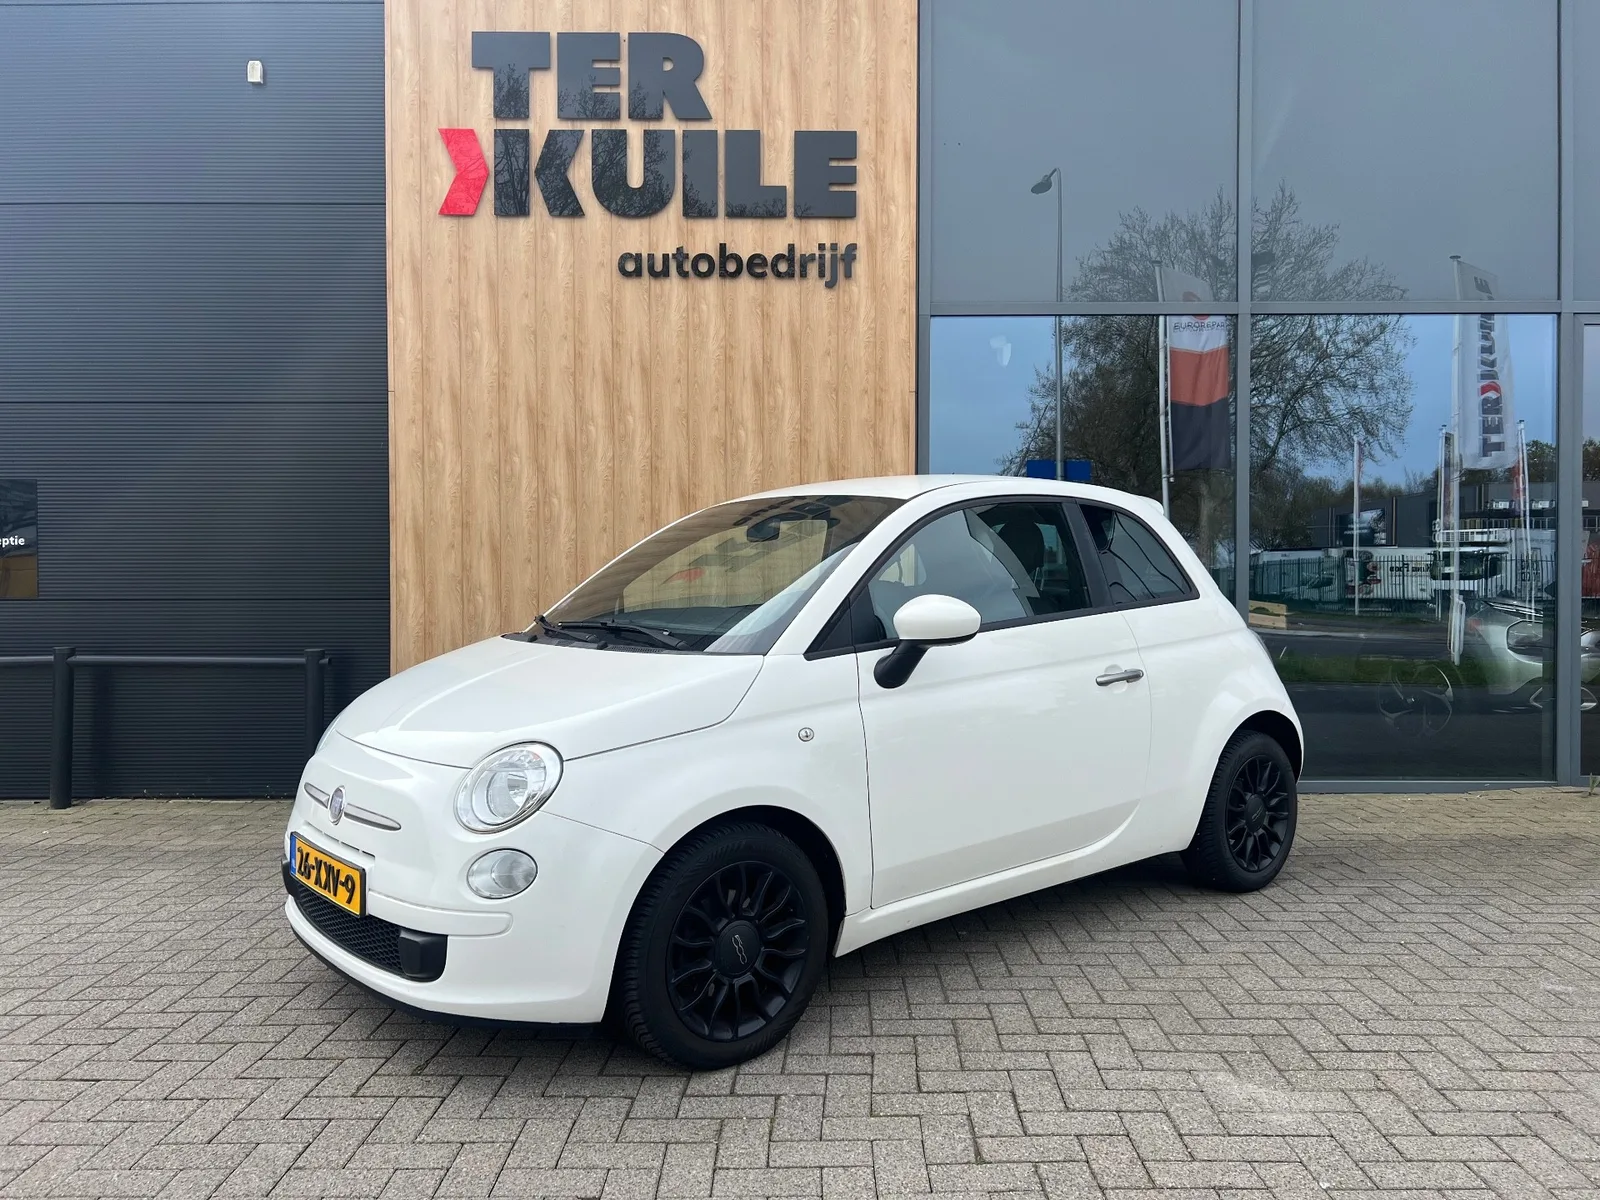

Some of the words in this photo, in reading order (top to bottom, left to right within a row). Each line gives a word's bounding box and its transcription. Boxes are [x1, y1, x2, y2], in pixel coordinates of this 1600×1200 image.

[471, 31, 712, 120] TER
[493, 128, 857, 218] KUILE
[617, 242, 857, 288] autobedrijf
[1172, 320, 1226, 331] EUROREPAR
[0, 535, 25, 548] ptie
[297, 846, 356, 905] 26-XXN-9
